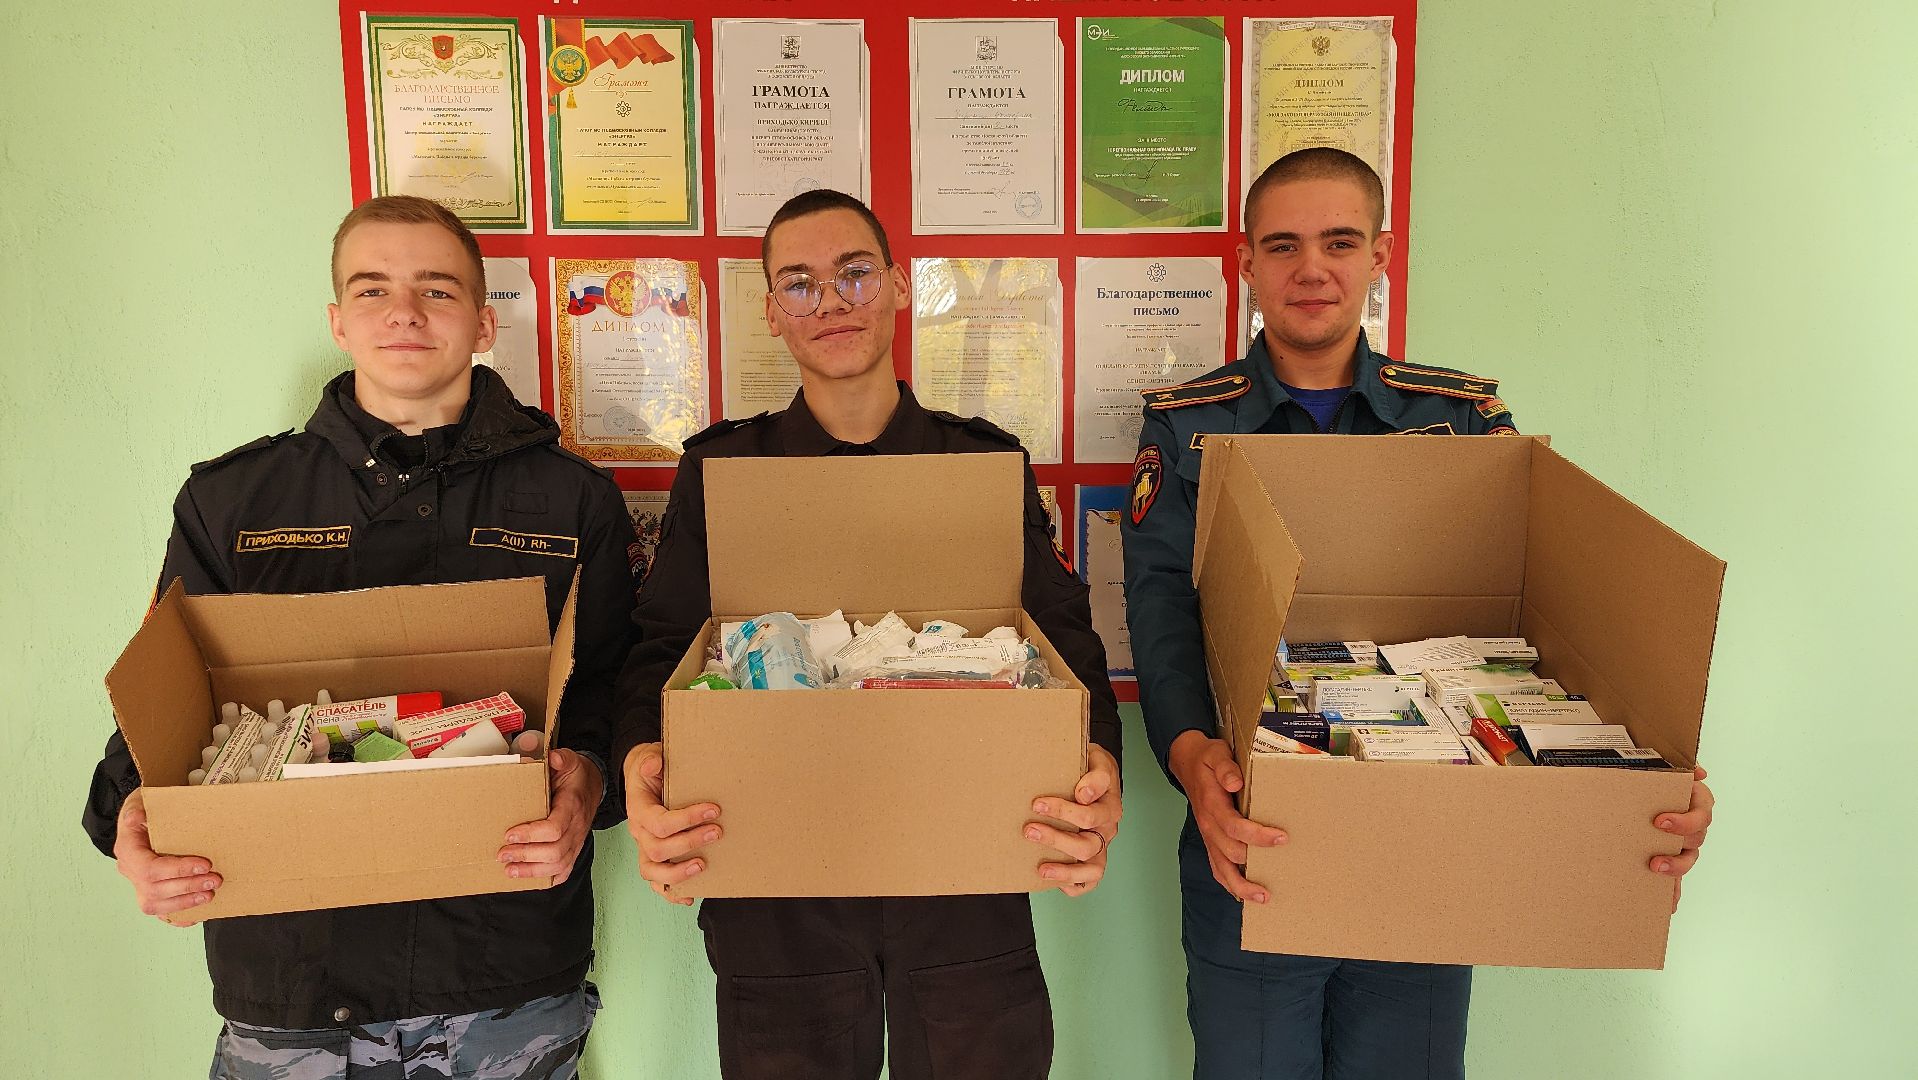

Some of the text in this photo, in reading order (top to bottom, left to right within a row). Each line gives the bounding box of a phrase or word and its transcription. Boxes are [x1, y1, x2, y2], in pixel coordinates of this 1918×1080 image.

[593, 72, 649, 91] Грамота
[1119, 69, 1185, 85] ДИПЛОМ
[394, 84, 500, 94] БЛАГОДАРСТВЕННОЕ
[1293, 79, 1345, 88] ДИПЛОМ
[751, 85, 831, 98] ГРАМОТА
[947, 87, 1027, 99] ГРАМОТА
[424, 95, 472, 104] ПИСЬМО
[753, 101, 832, 110] НАГРАЖДАЕТСЯ
[1096, 287, 1214, 302] Благодарственное
[1133, 306, 1180, 316] письмо
[591, 320, 666, 333] ДИПЛОМ
[245, 531, 347, 547] ПРИХОДЬКО К.Н.
[530, 539, 552, 549] Rh-
[316, 716, 340, 725] пена
